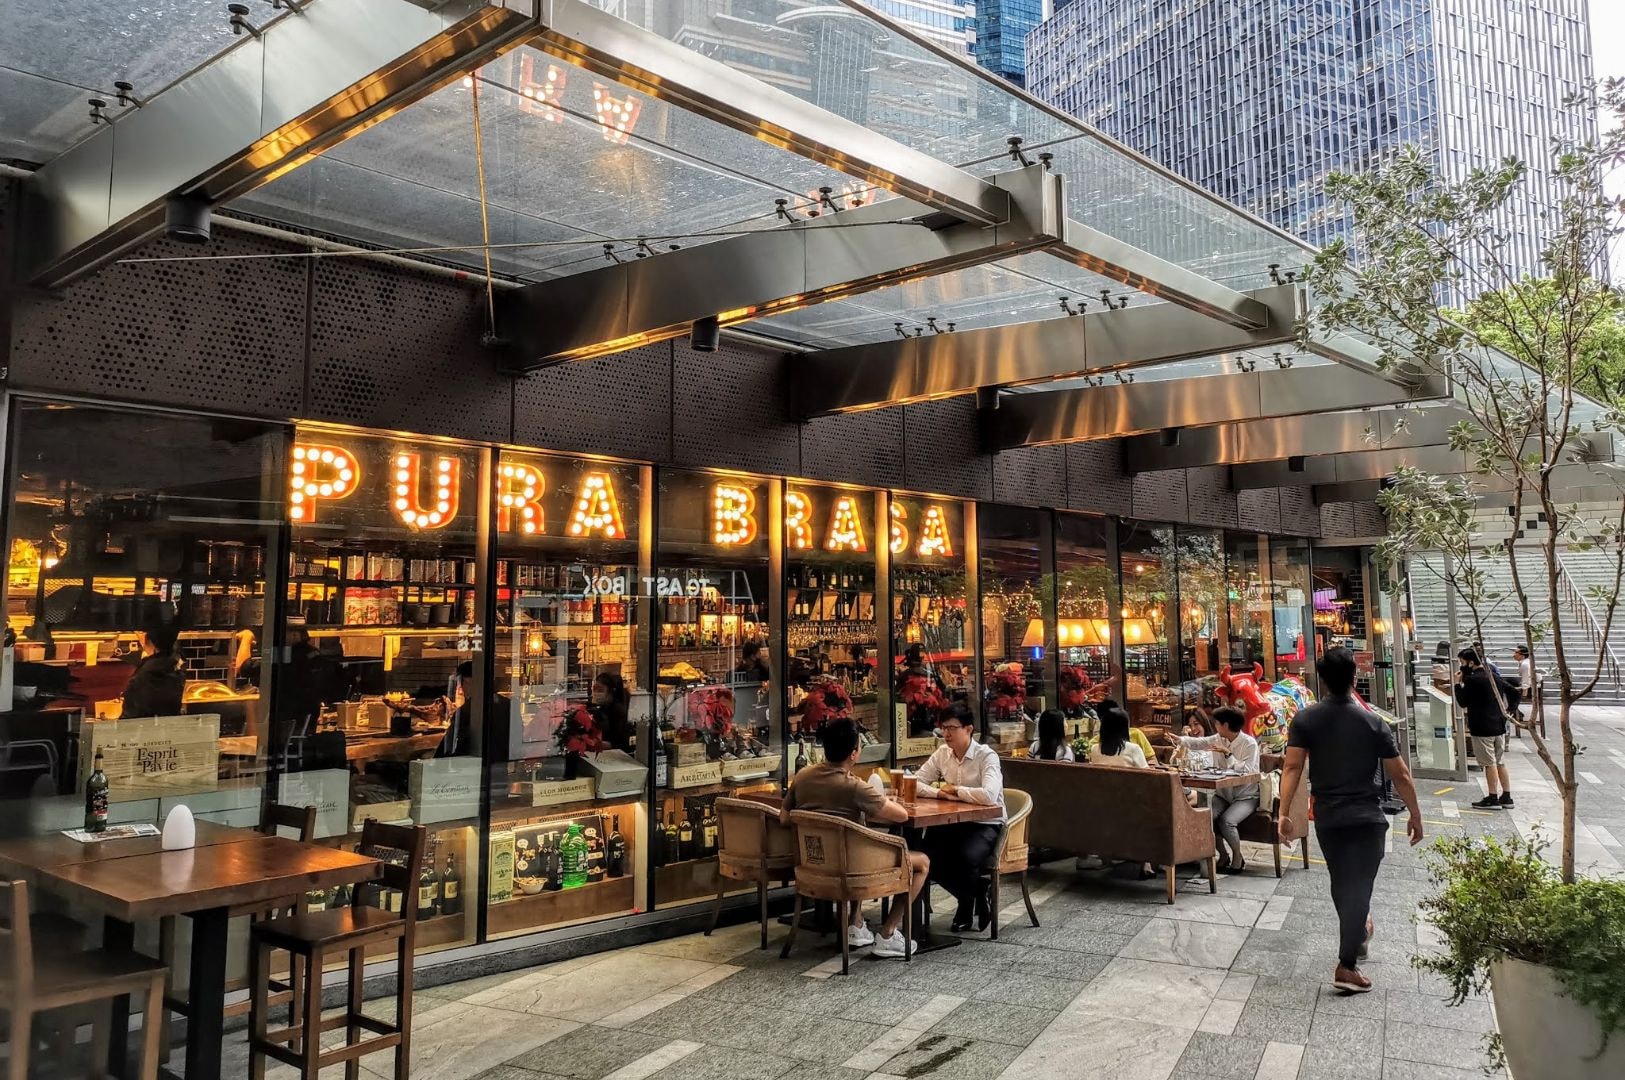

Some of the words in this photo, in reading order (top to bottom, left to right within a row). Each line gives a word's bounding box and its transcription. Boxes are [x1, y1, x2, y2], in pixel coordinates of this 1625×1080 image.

[290, 442, 626, 540] PURA
[711, 483, 954, 558] BRASA
[137, 747, 179, 764] Esprit
[142, 760, 178, 774] Pavie
